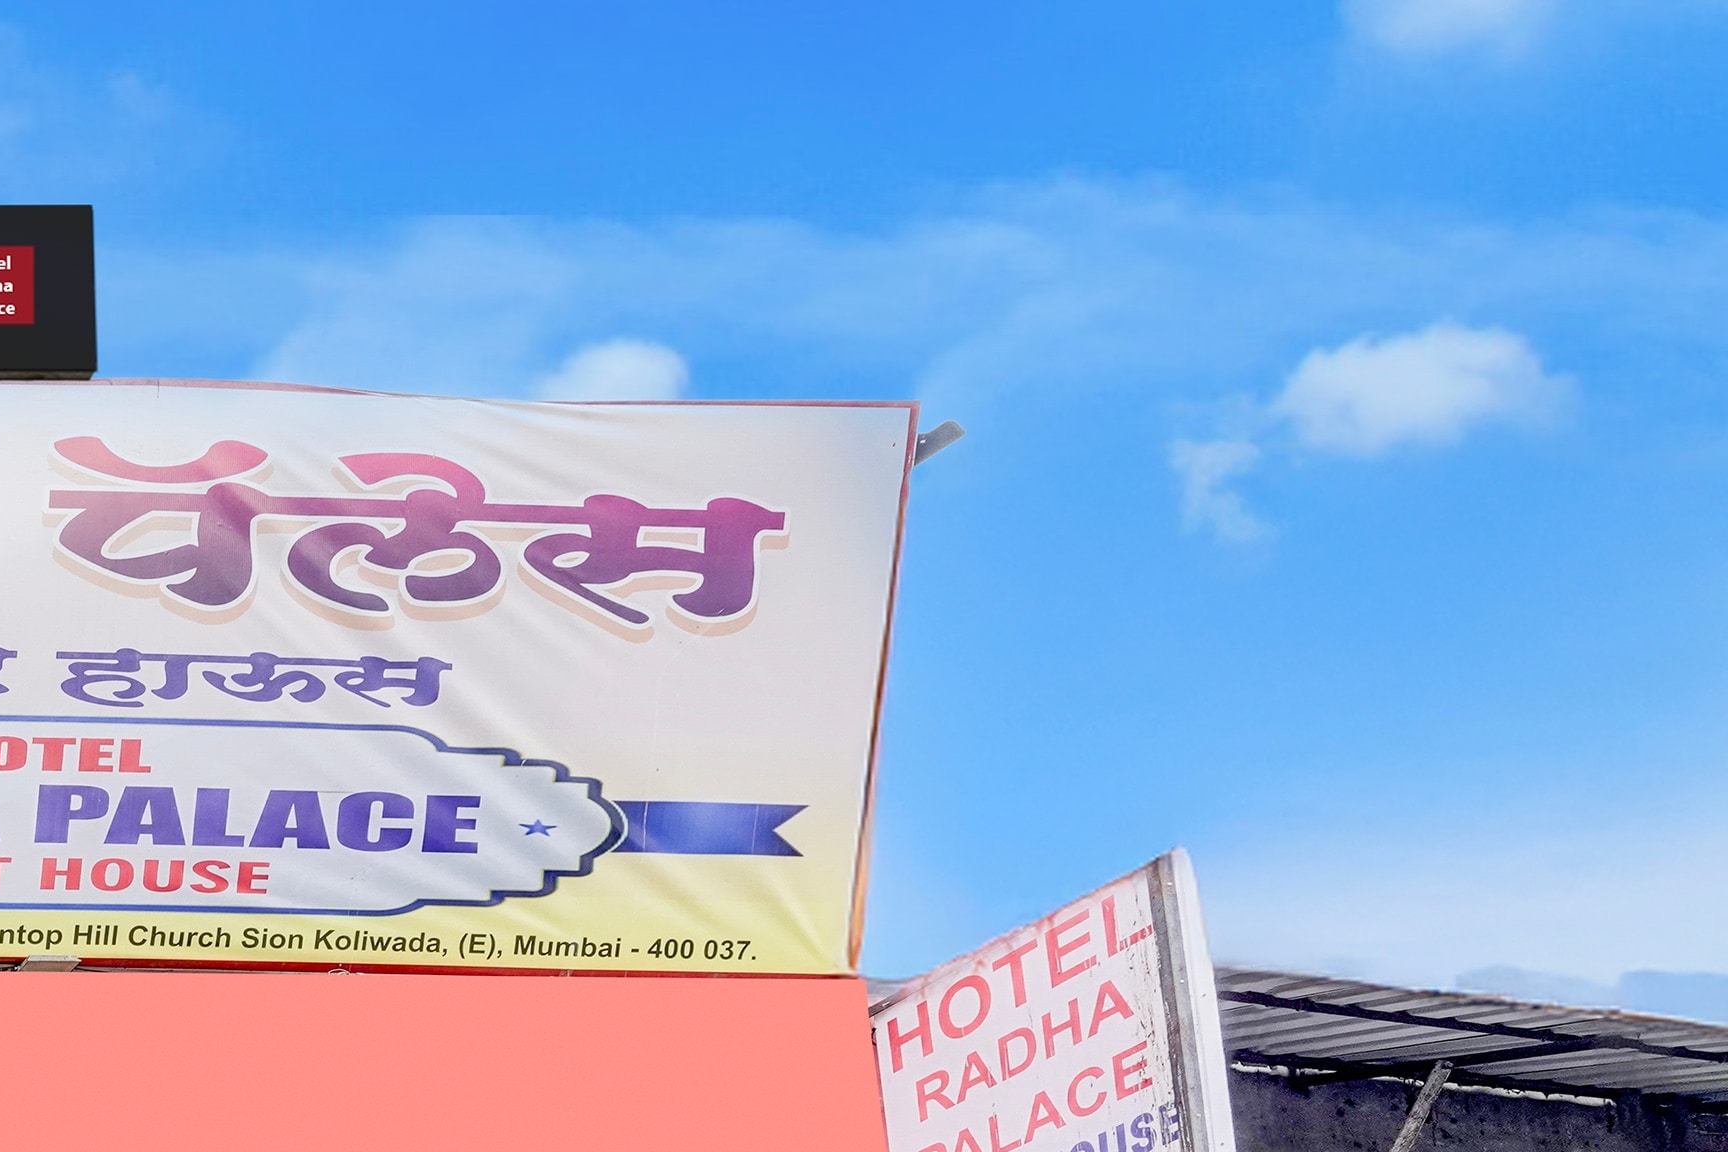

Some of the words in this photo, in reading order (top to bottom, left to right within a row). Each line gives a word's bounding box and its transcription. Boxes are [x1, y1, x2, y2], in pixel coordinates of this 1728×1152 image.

[48, 435, 788, 628] पॅलेस
[56, 648, 453, 708] हाऊस
[34, 785, 482, 855] PALACE
[39, 858, 271, 895] HOUSE
[72, 924, 120, 947] Hill
[127, 925, 233, 949] Church
[240, 927, 305, 950] Sion
[314, 929, 450, 957] Koliwada,
[458, 933, 504, 960] (E),
[513, 934, 623, 959] Mumbai
[647, 938, 695, 960] 400
[702, 939, 759, 962] 037.
[886, 896, 1156, 1074] HOTEL
[914, 980, 1135, 1123] RADHA
